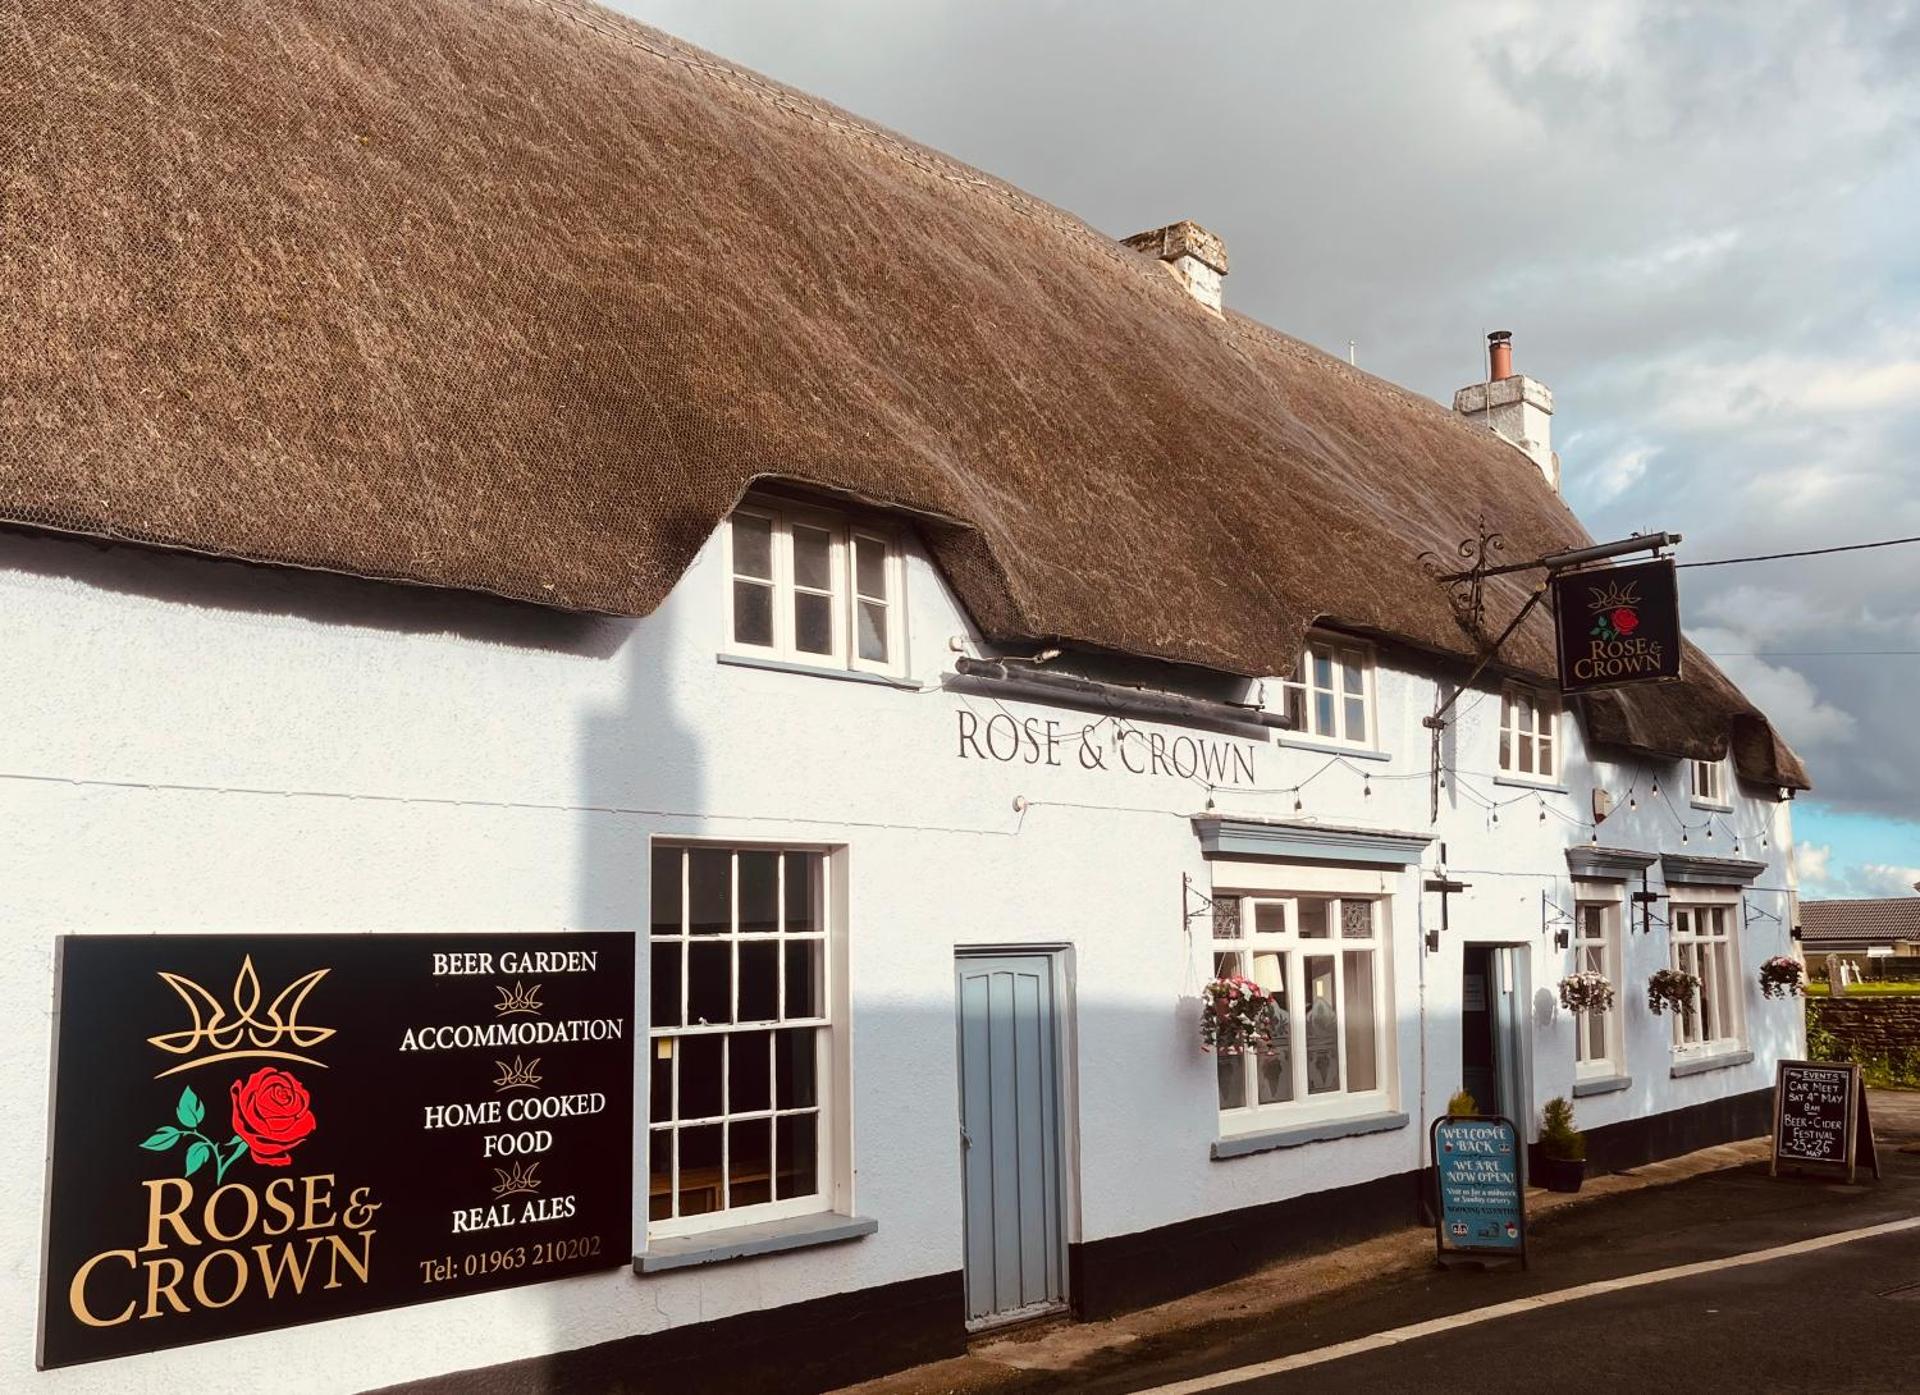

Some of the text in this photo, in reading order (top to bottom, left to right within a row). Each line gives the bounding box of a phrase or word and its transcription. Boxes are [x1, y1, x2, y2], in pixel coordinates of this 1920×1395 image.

[1590, 638, 1664, 659] ROSE &
[1574, 654, 1662, 679] CROWN
[956, 709, 1256, 785] ROSE & CROWN
[433, 951, 598, 975] BEER GARDEN
[400, 1019, 623, 1051] ACCOMMODATION
[1789, 1081, 1839, 1093] CAR MEET
[1803, 1071, 1839, 1081] EVENTS
[1788, 1093, 1804, 1102] SAT
[1821, 1093, 1843, 1104] MAY
[424, 1092, 606, 1129] HOME COOKED
[1784, 1114, 1807, 1127] BEER
[1813, 1116, 1842, 1129] CIDER
[1441, 1126, 1506, 1140] WELCOME
[1793, 1127, 1836, 1140] FESTIVAL
[484, 1131, 552, 1158] FOOD
[1456, 1140, 1495, 1153] BACK
[1447, 1171, 1476, 1184] NOW
[1454, 1161, 1499, 1174] WE ARE
[139, 1174, 383, 1252] ROSE &
[452, 1196, 576, 1234] REAL ALES
[420, 1236, 602, 1285] Tel: 01963 210202
[69, 1231, 377, 1327] CROWN
